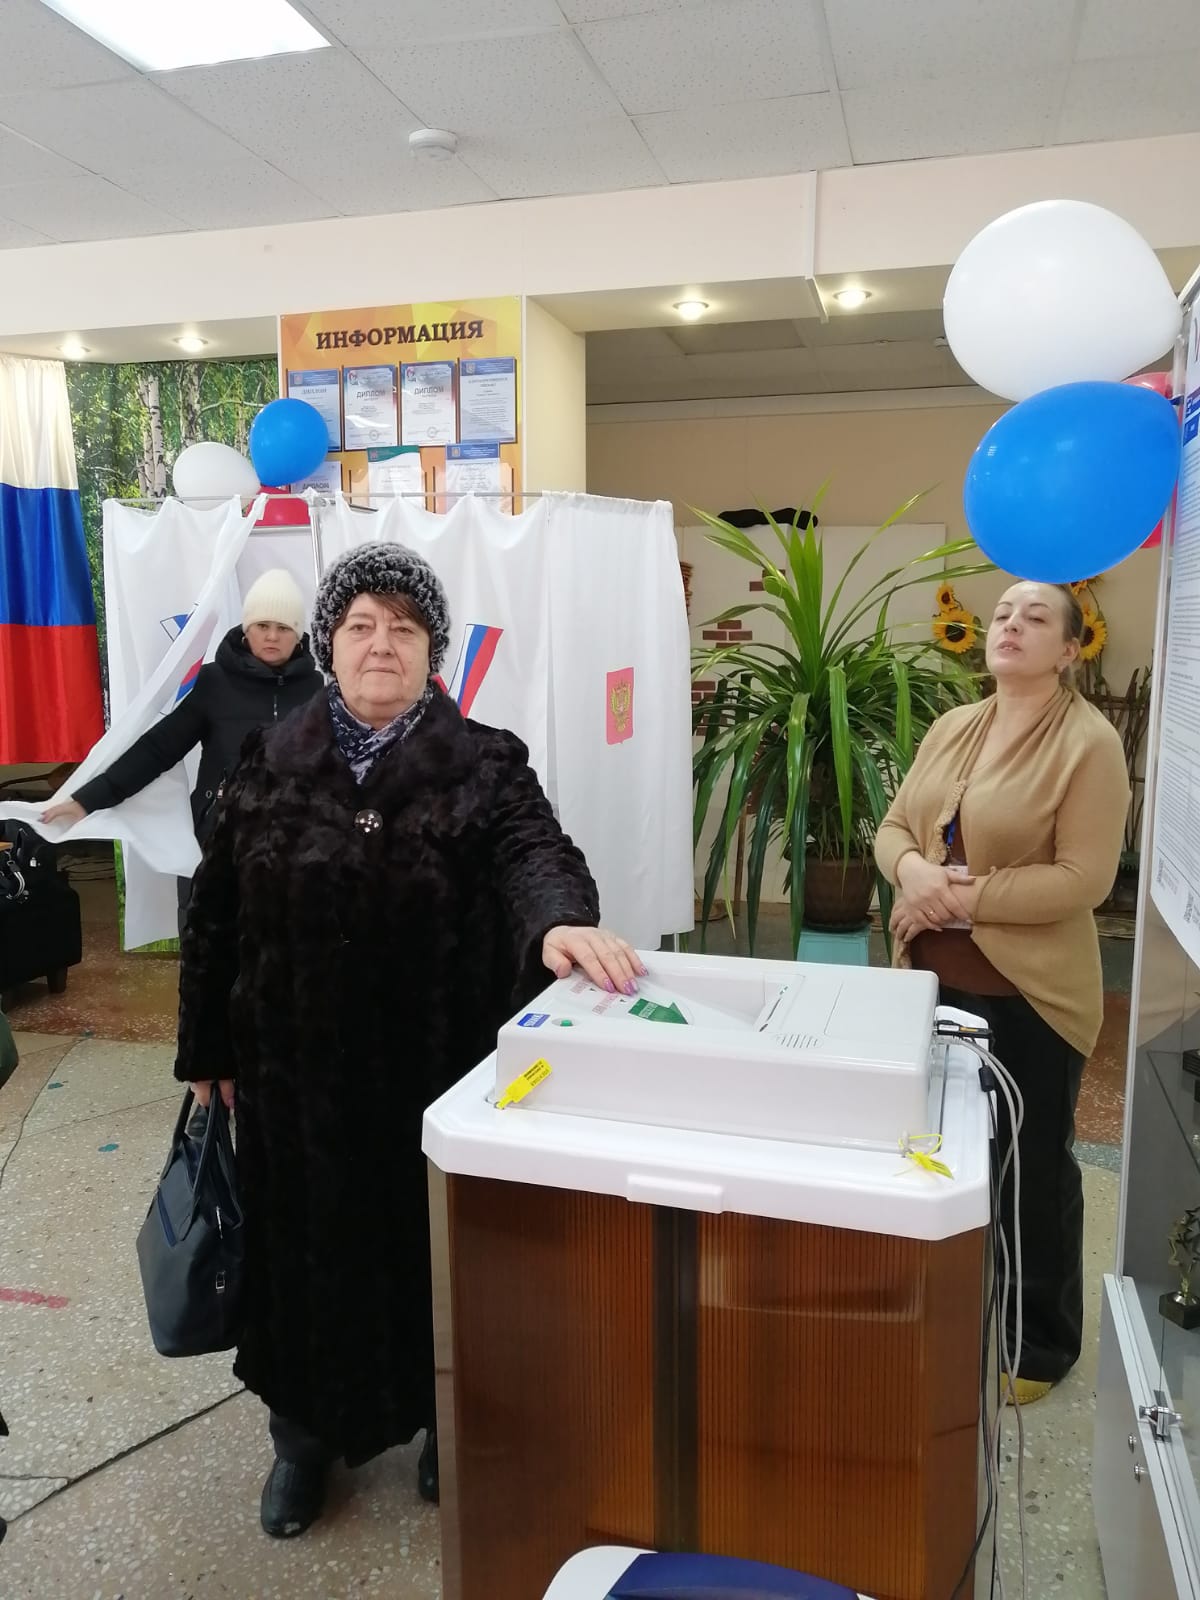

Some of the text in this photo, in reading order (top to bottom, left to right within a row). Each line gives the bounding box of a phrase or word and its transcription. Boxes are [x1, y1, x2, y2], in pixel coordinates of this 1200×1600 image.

[316, 319, 484, 350] ИНФОРМАЦИЯ
[356, 390, 386, 399] ДИПЛОМ
[414, 386, 444, 395] ДИПЛОМ
